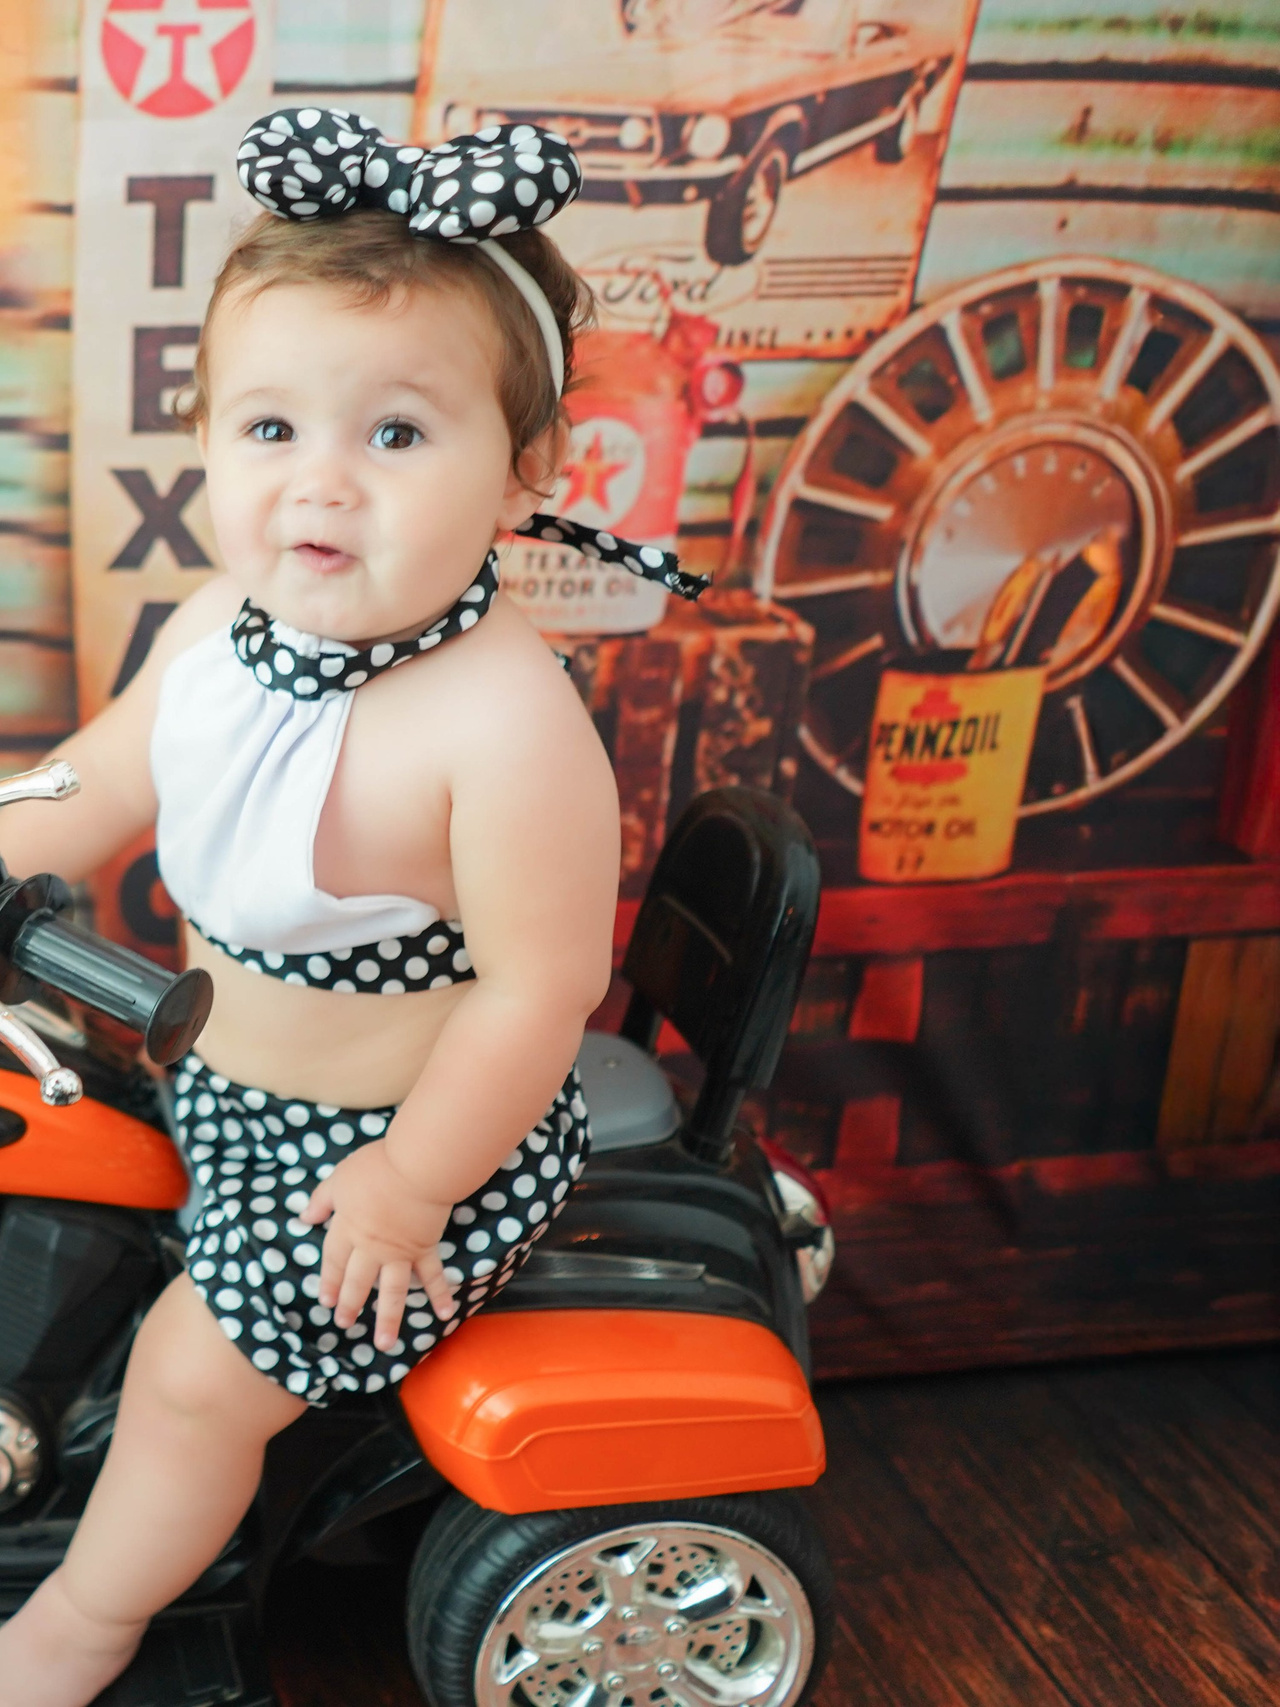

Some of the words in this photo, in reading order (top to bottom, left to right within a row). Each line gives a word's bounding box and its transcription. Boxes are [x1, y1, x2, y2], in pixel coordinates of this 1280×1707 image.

[603, 253, 724, 304] Ford
[524, 551, 610, 571] TEXA
[873, 711, 1002, 762] PENNZOIL
